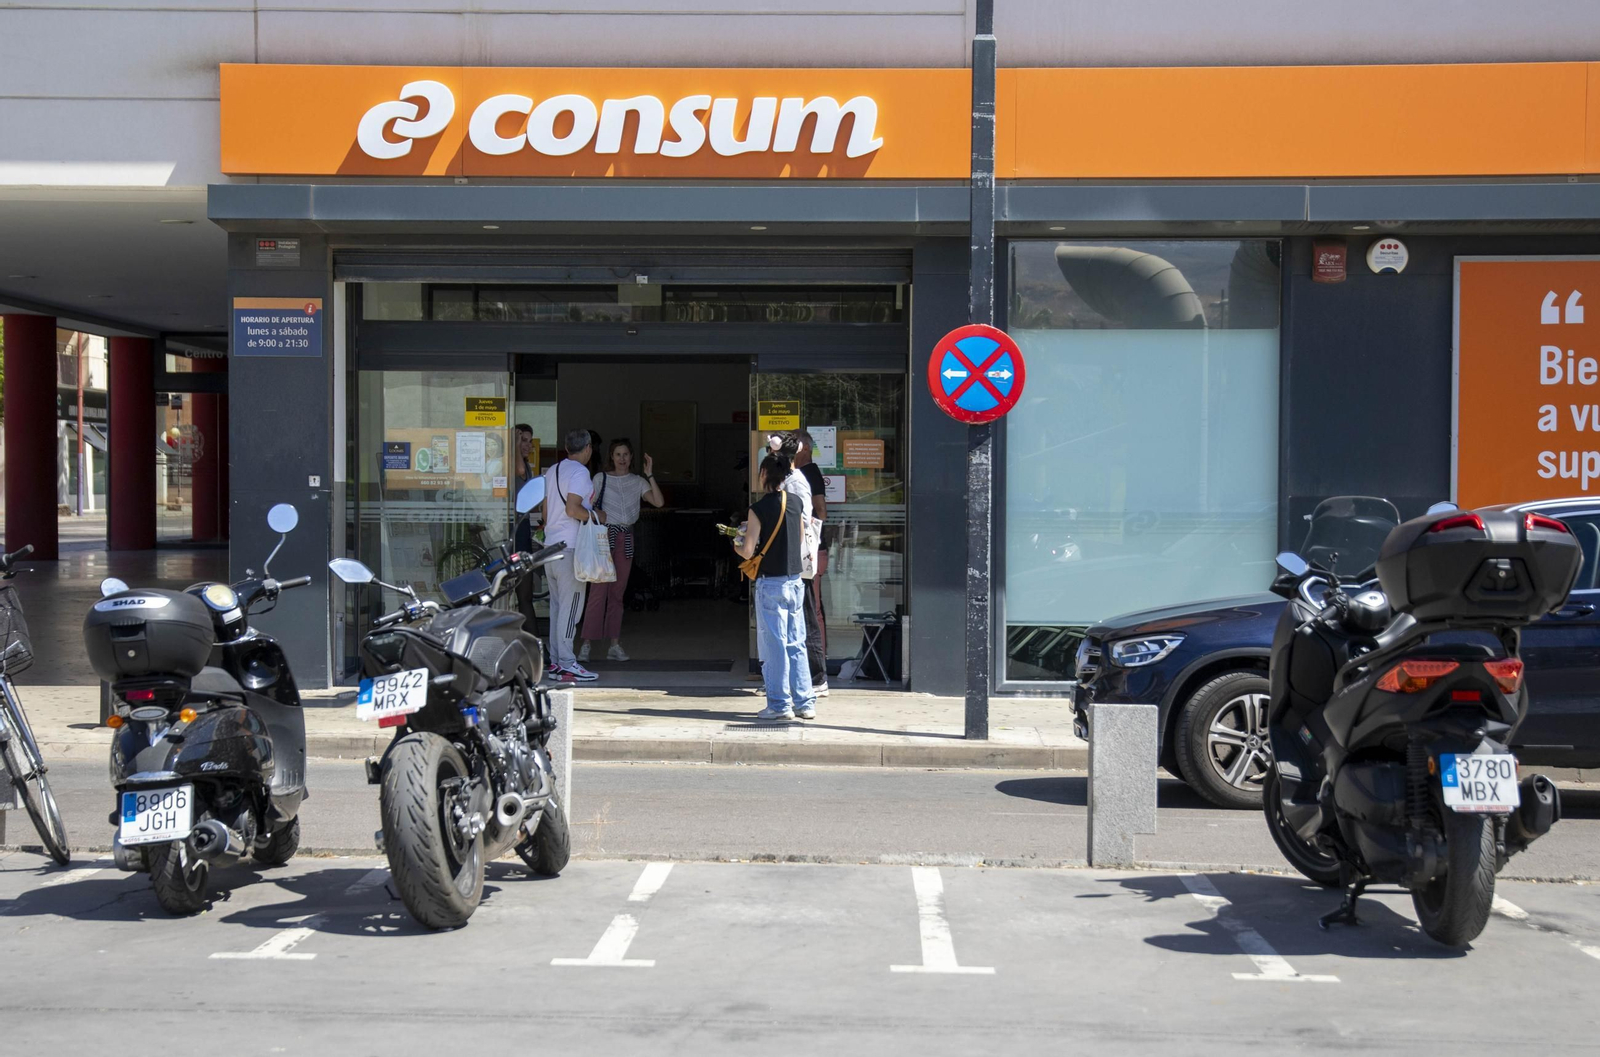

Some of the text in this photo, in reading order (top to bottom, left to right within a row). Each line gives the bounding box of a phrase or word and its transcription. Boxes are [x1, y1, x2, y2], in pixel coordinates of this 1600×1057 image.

[468, 94, 884, 157] consum
[247, 326, 269, 335] lunes
[279, 326, 308, 335] sábado
[185, 348, 223, 359] Centro
[247, 339, 257, 347] de
[258, 339, 276, 347] 9:00
[285, 339, 308, 347] 21:30
[1540, 345, 1598, 385] Bie
[1537, 404, 1558, 431] a
[1537, 451, 1600, 491] sup
[112, 599, 146, 607] SHAD
[375, 672, 423, 695] 9942
[373, 691, 410, 711] MRX
[1460, 759, 1511, 779] 3780
[136, 790, 187, 813] 8906
[1461, 781, 1501, 802] MBX
[139, 811, 176, 832] JGH
